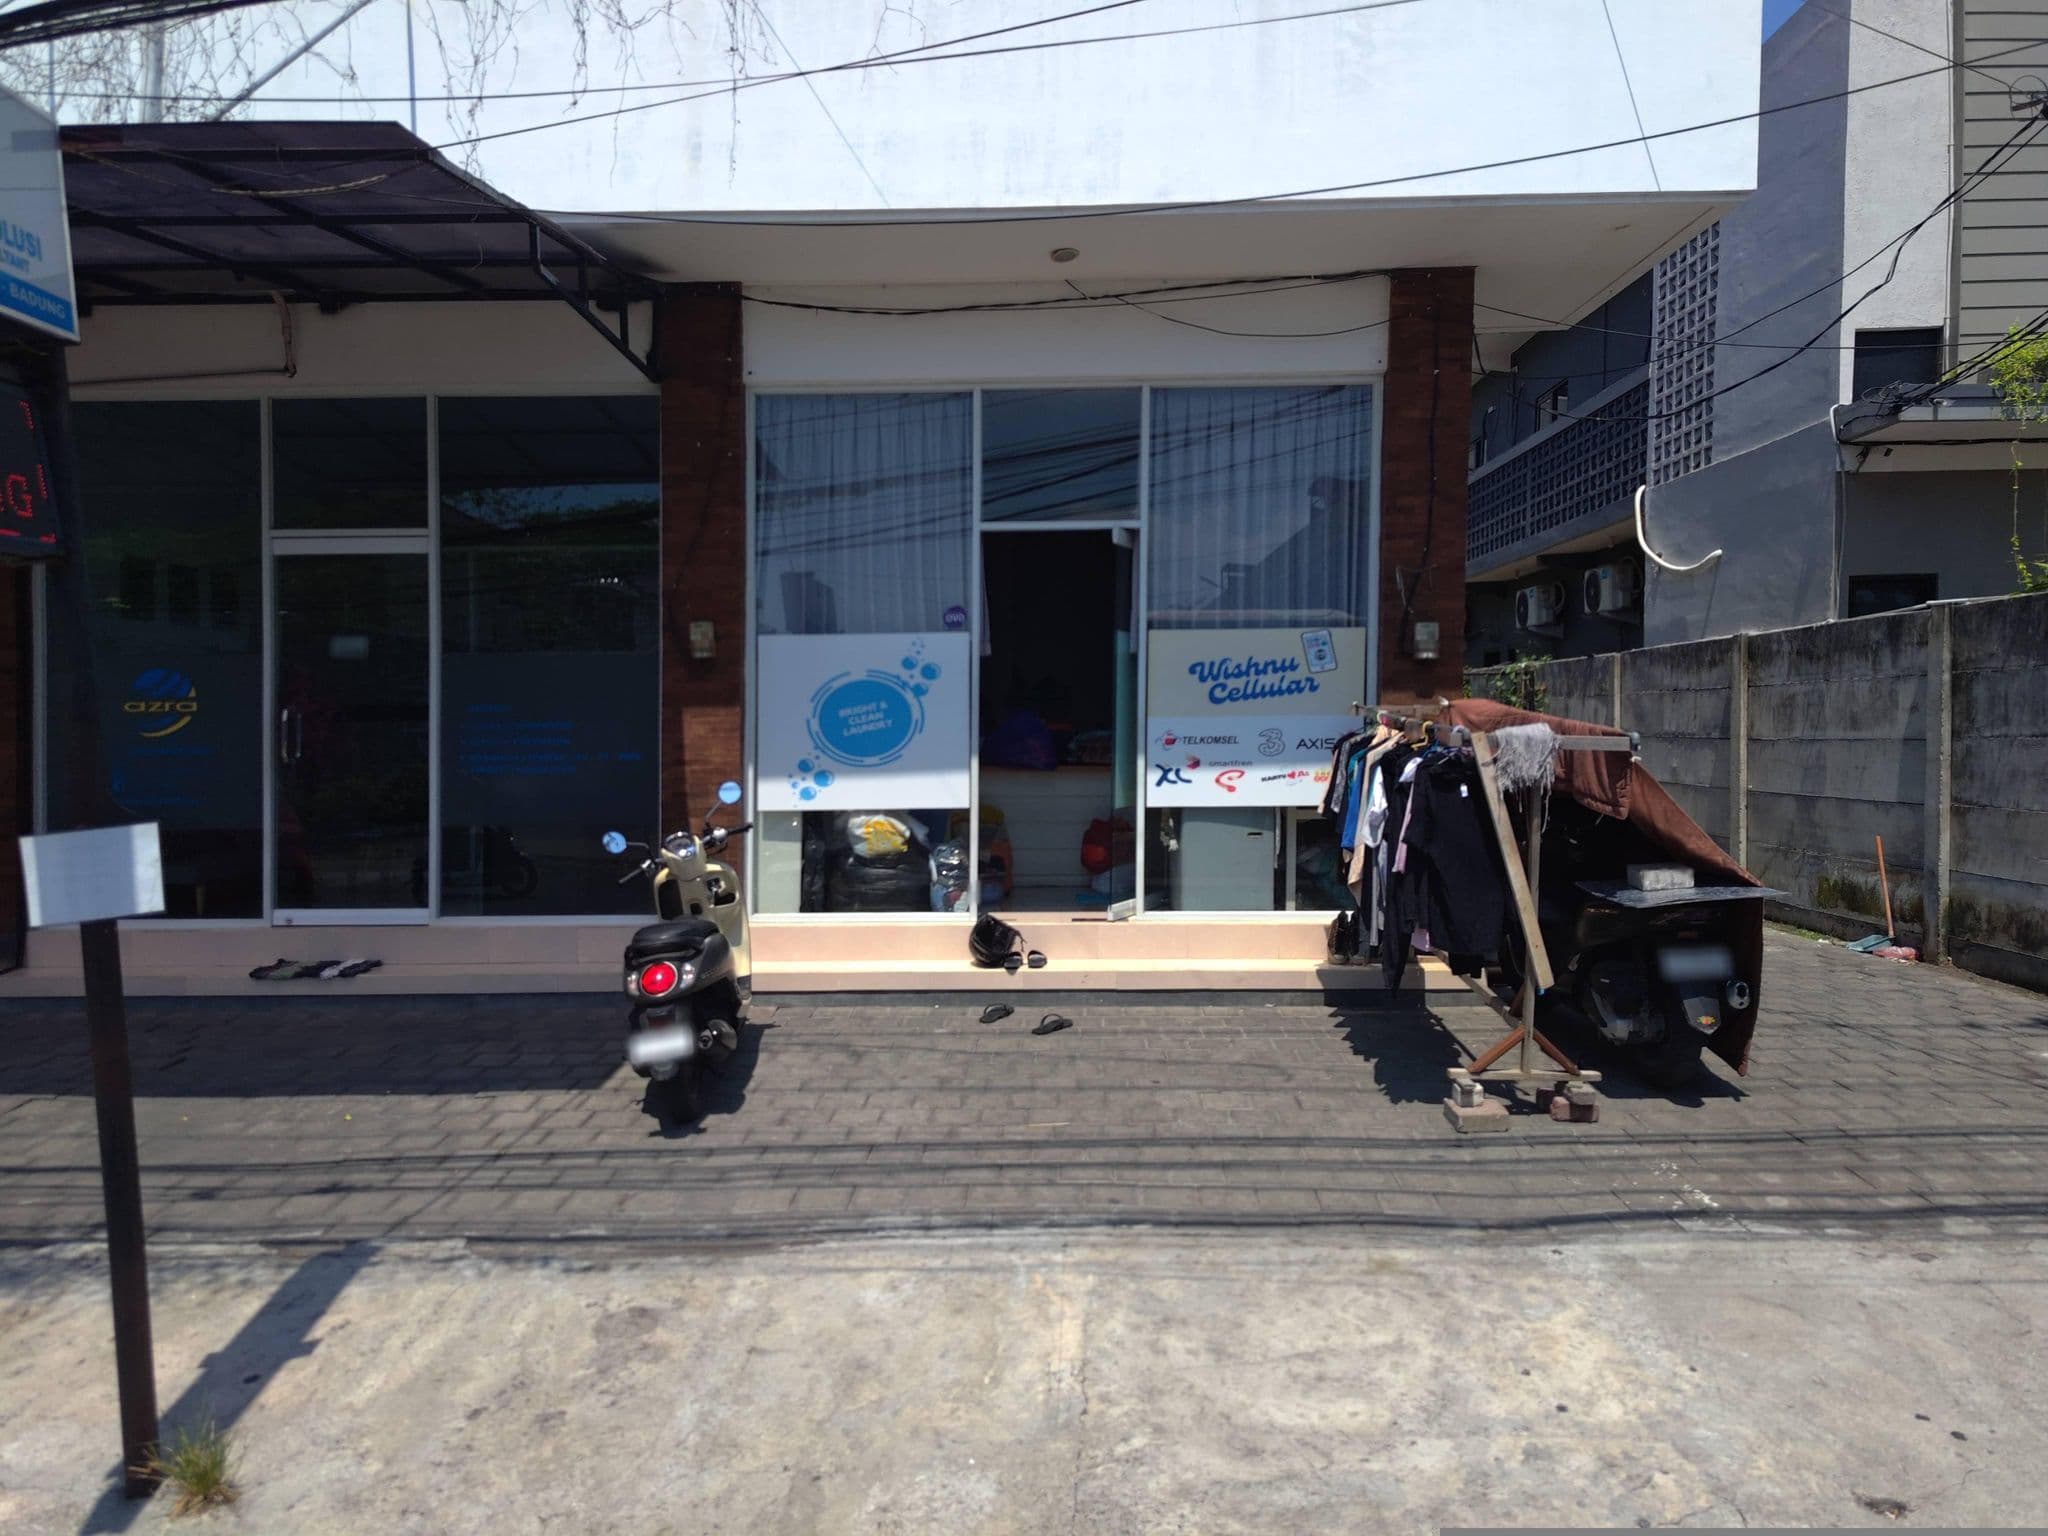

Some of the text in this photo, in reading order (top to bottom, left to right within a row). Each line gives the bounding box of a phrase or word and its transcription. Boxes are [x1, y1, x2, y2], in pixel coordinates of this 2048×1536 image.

[9, 282, 66, 319] BADUNG
[1188, 656, 1300, 683] Wishnu
[1208, 675, 1320, 704] Cellular
[123, 700, 198, 713] azra
[842, 719, 893, 736] LAUNDRY
[848, 711, 885, 725] CLEAN
[1182, 736, 1240, 745] TELKOMSEL
[1258, 728, 1286, 757] 3
[1296, 738, 1337, 750] AXIS
[1155, 763, 1193, 787] XL
